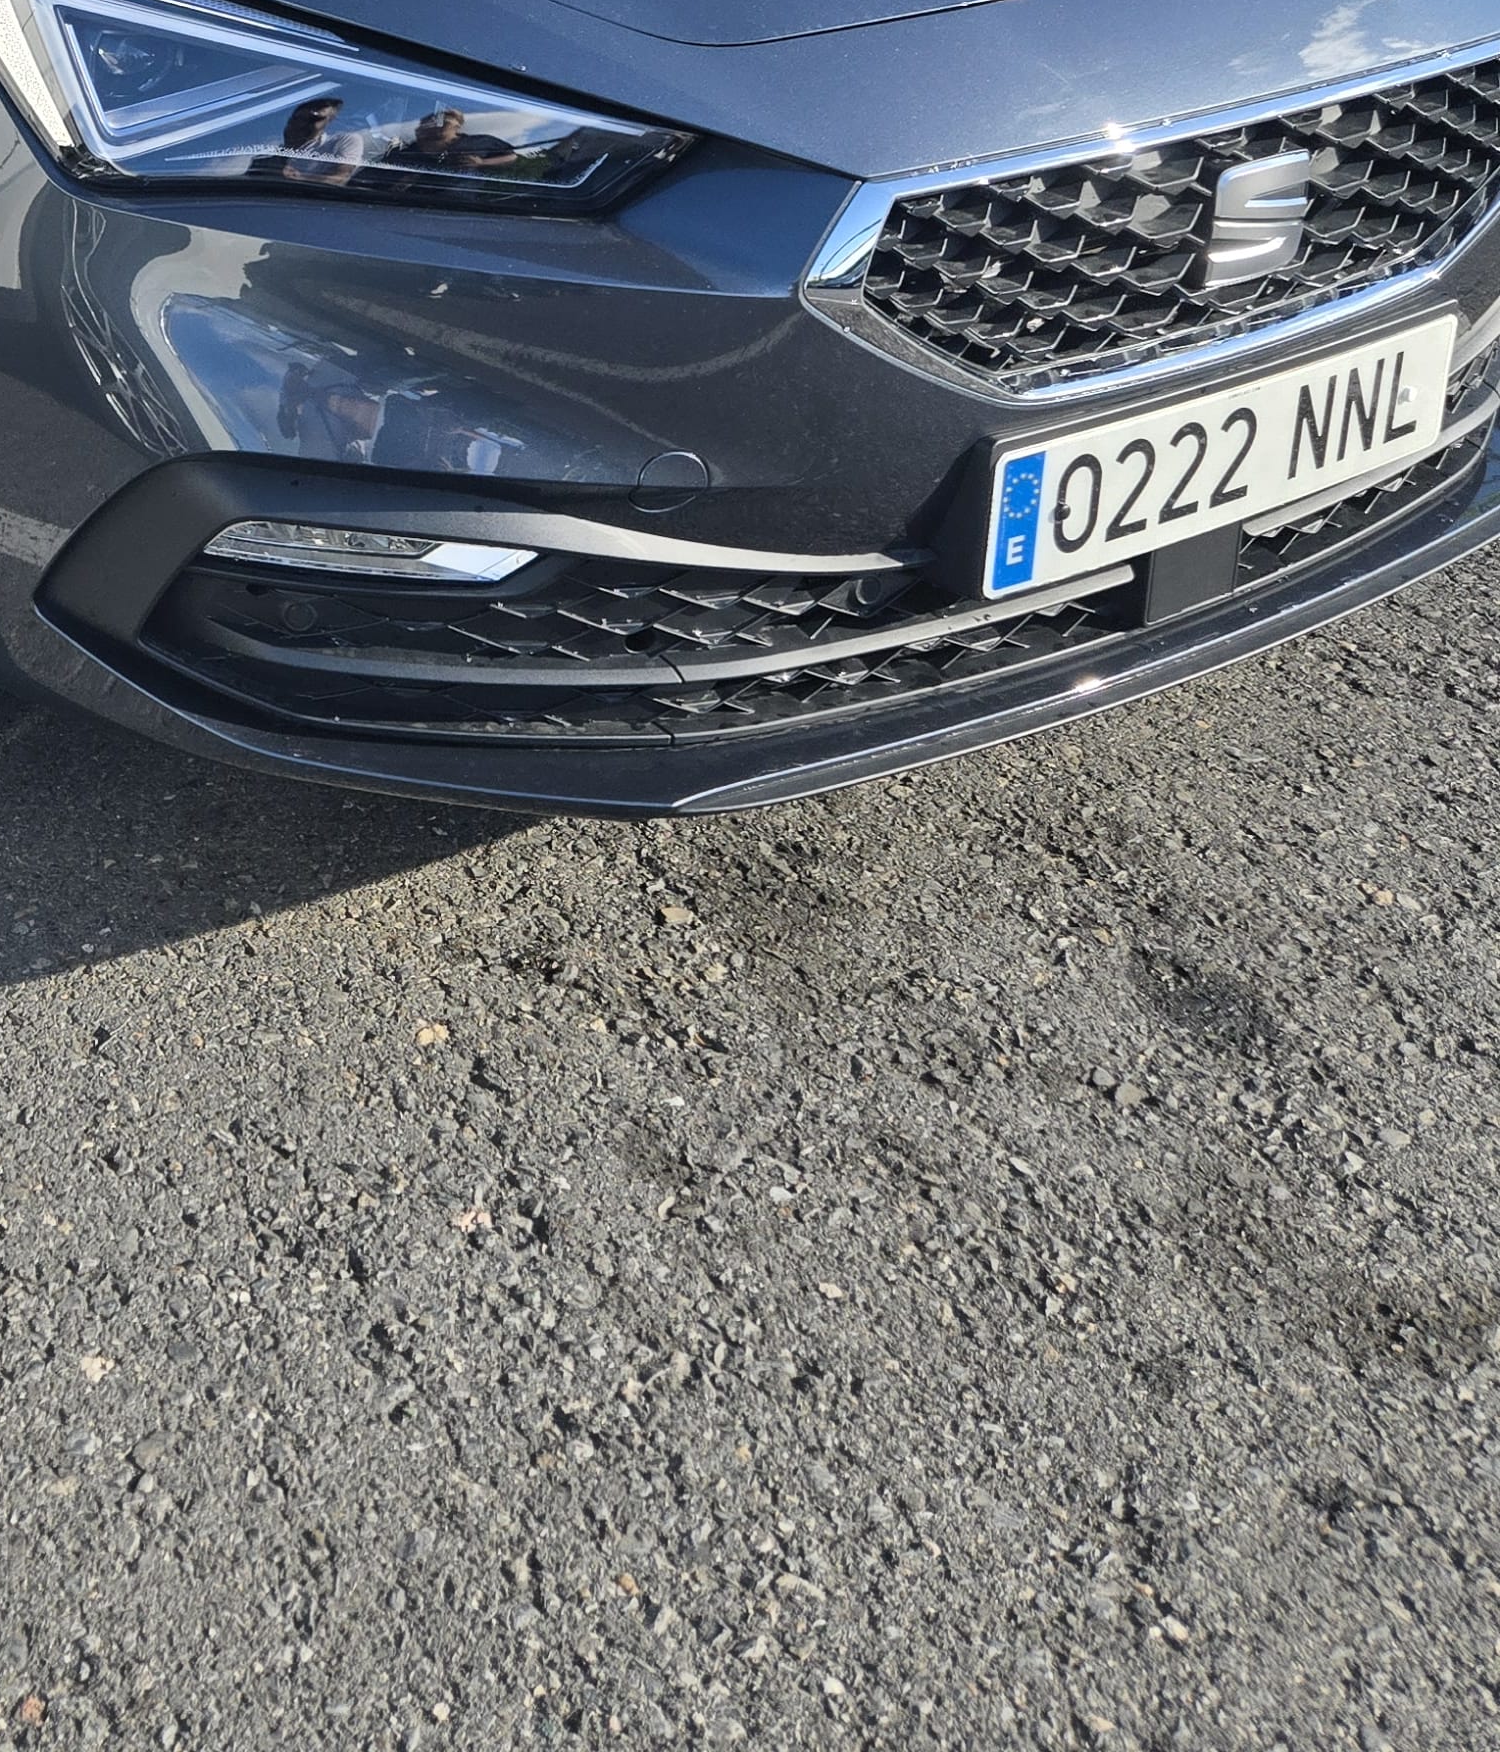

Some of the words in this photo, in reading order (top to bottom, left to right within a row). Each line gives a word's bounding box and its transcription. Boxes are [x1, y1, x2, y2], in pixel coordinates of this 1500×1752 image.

[1006, 536, 1026, 566] E
[1053, 407, 1258, 554] 0222
[1287, 351, 1418, 480] NNL
